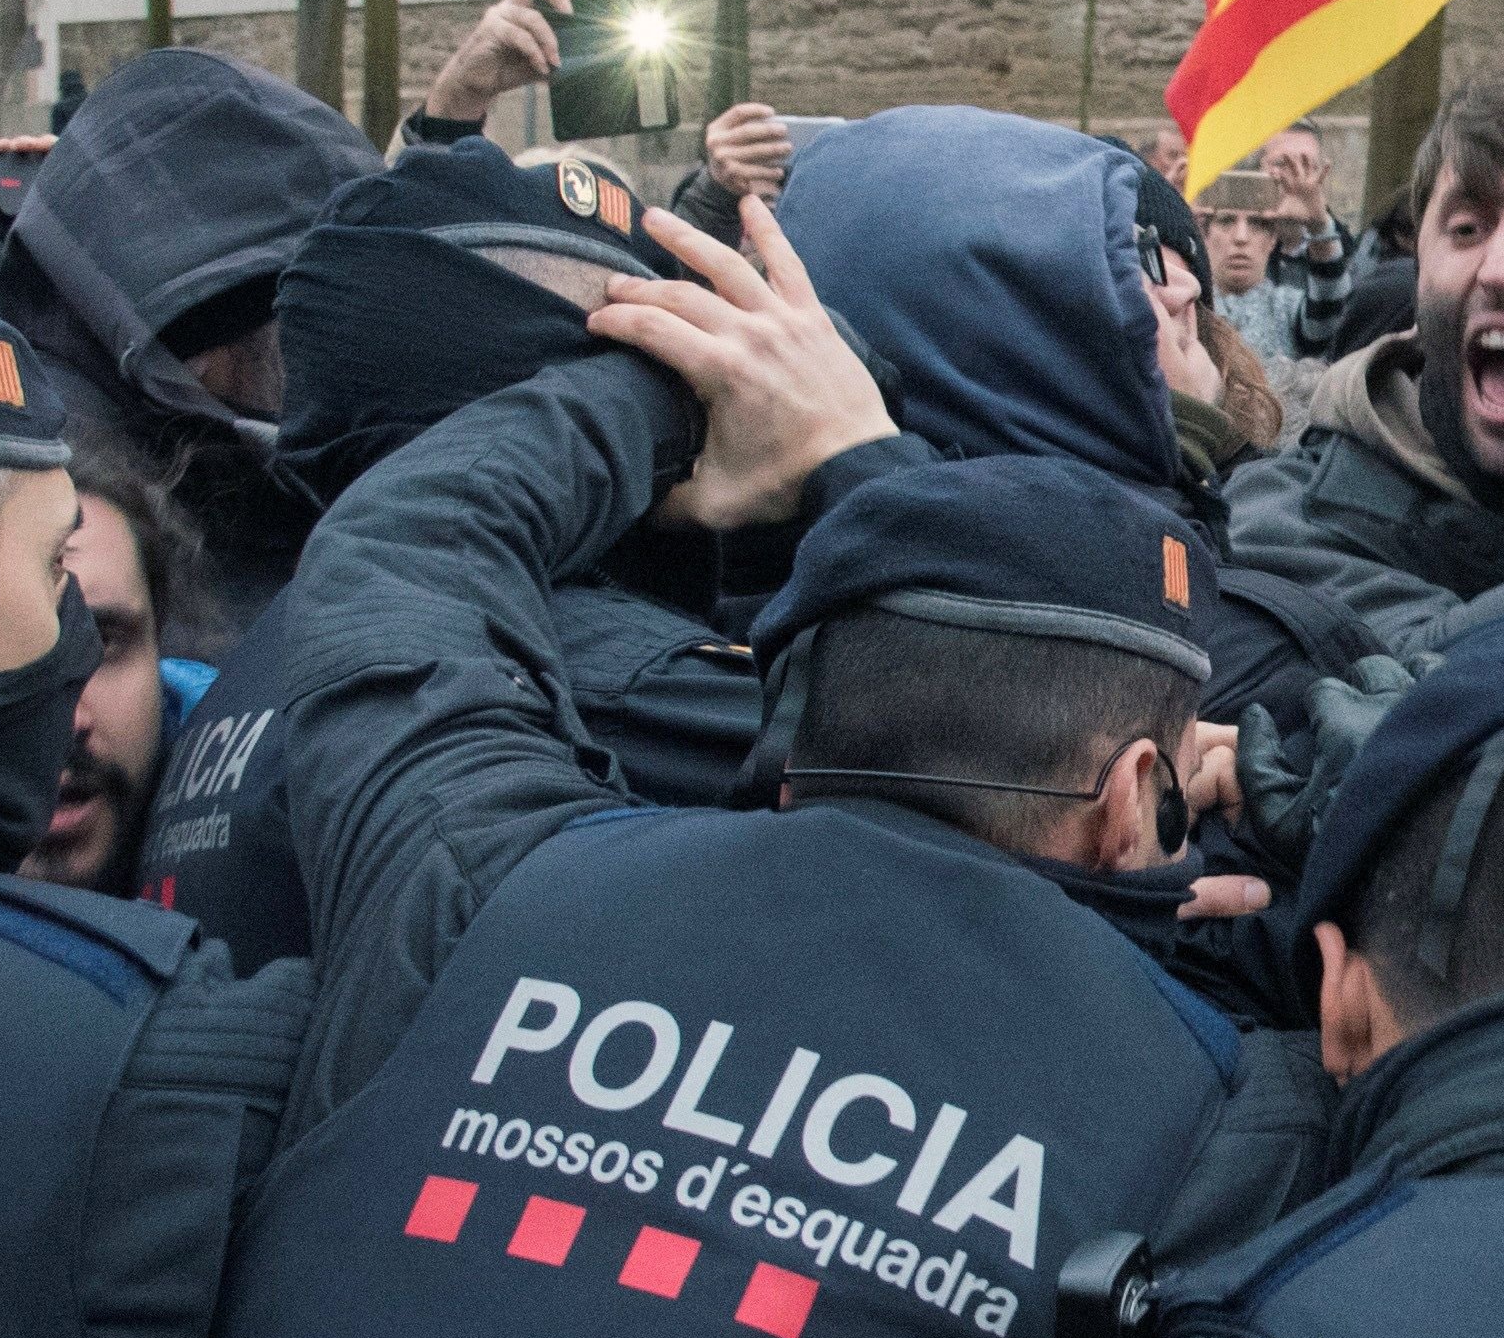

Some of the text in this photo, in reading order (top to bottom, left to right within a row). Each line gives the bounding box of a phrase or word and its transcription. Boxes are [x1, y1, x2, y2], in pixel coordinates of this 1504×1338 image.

[157, 708, 275, 813] LICIA
[441, 1107, 665, 1194] mossos
[470, 976, 1046, 1270] POLICIA
